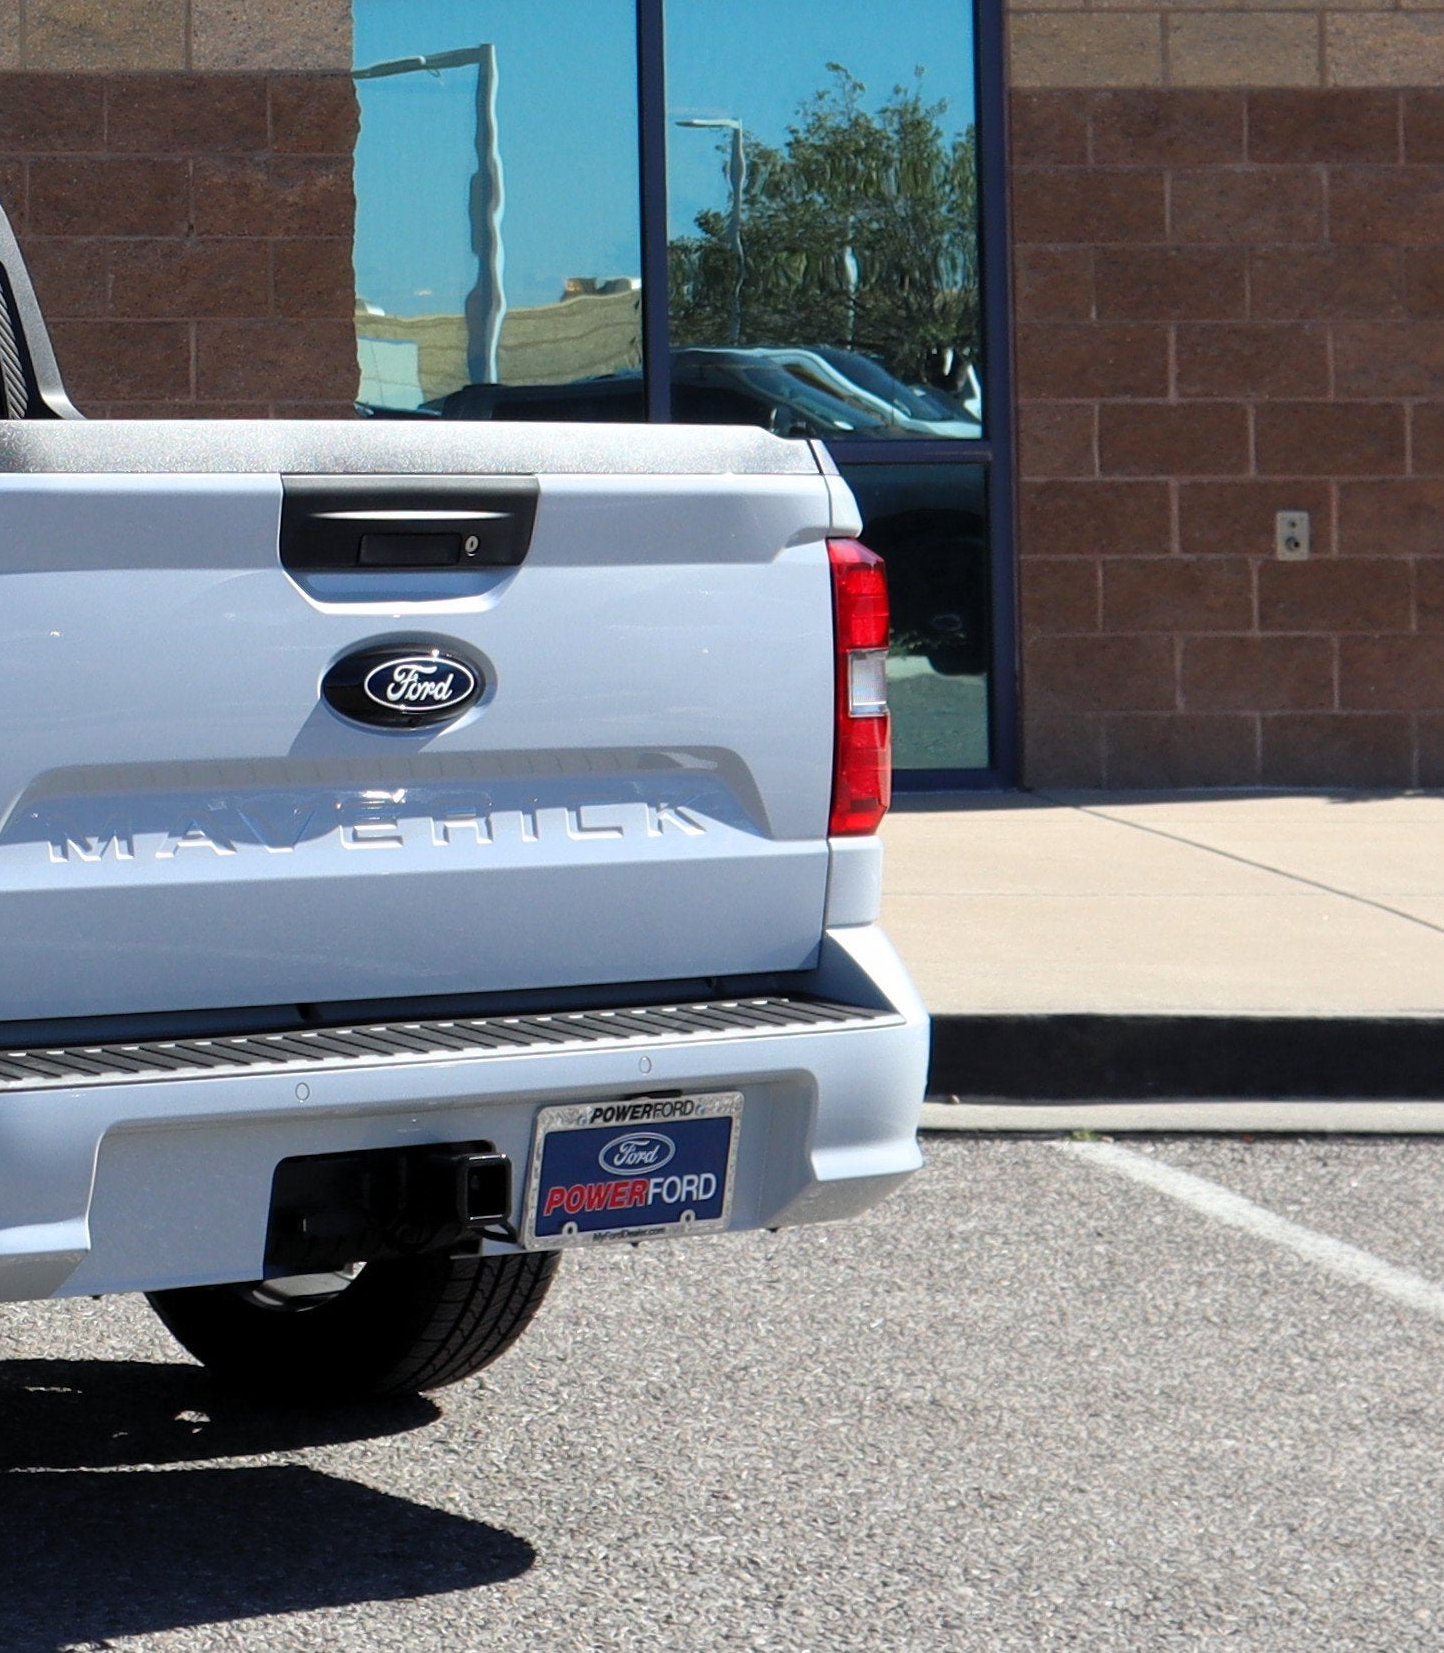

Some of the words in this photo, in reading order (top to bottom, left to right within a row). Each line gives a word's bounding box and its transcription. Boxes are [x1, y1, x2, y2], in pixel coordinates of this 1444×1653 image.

[386, 664, 454, 701] Ford
[47, 795, 709, 862] MAVERICK
[591, 1100, 694, 1123] POWERFORD
[614, 1140, 660, 1166] Ford
[544, 1174, 716, 1215] POWERFORD
